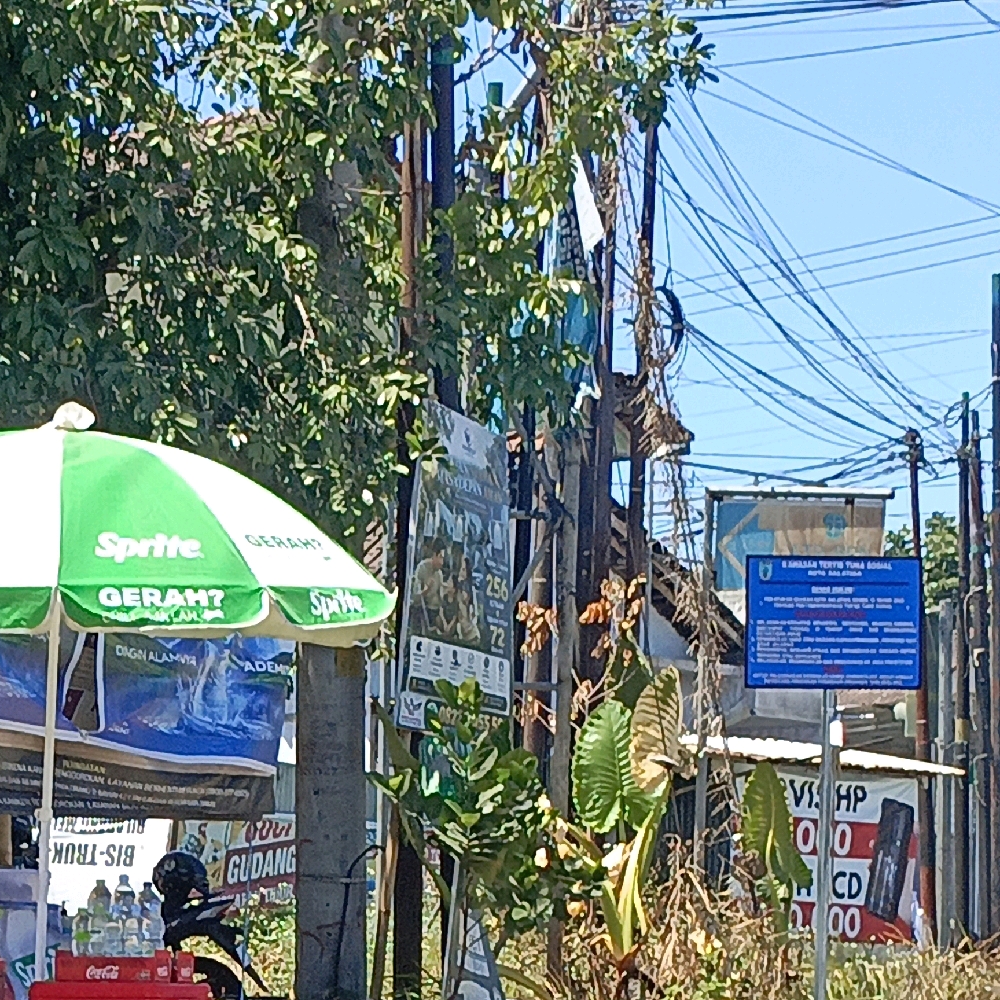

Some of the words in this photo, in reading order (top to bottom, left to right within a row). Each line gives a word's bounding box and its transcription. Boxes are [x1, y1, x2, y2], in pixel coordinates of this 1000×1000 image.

[95, 531, 205, 563] Sprite
[245, 534, 321, 551] GERAH?
[98, 586, 225, 607] GERAH?
[310, 588, 365, 620] Sprite
[835, 783, 868, 814] HP
[227, 845, 297, 884] GUDANG
